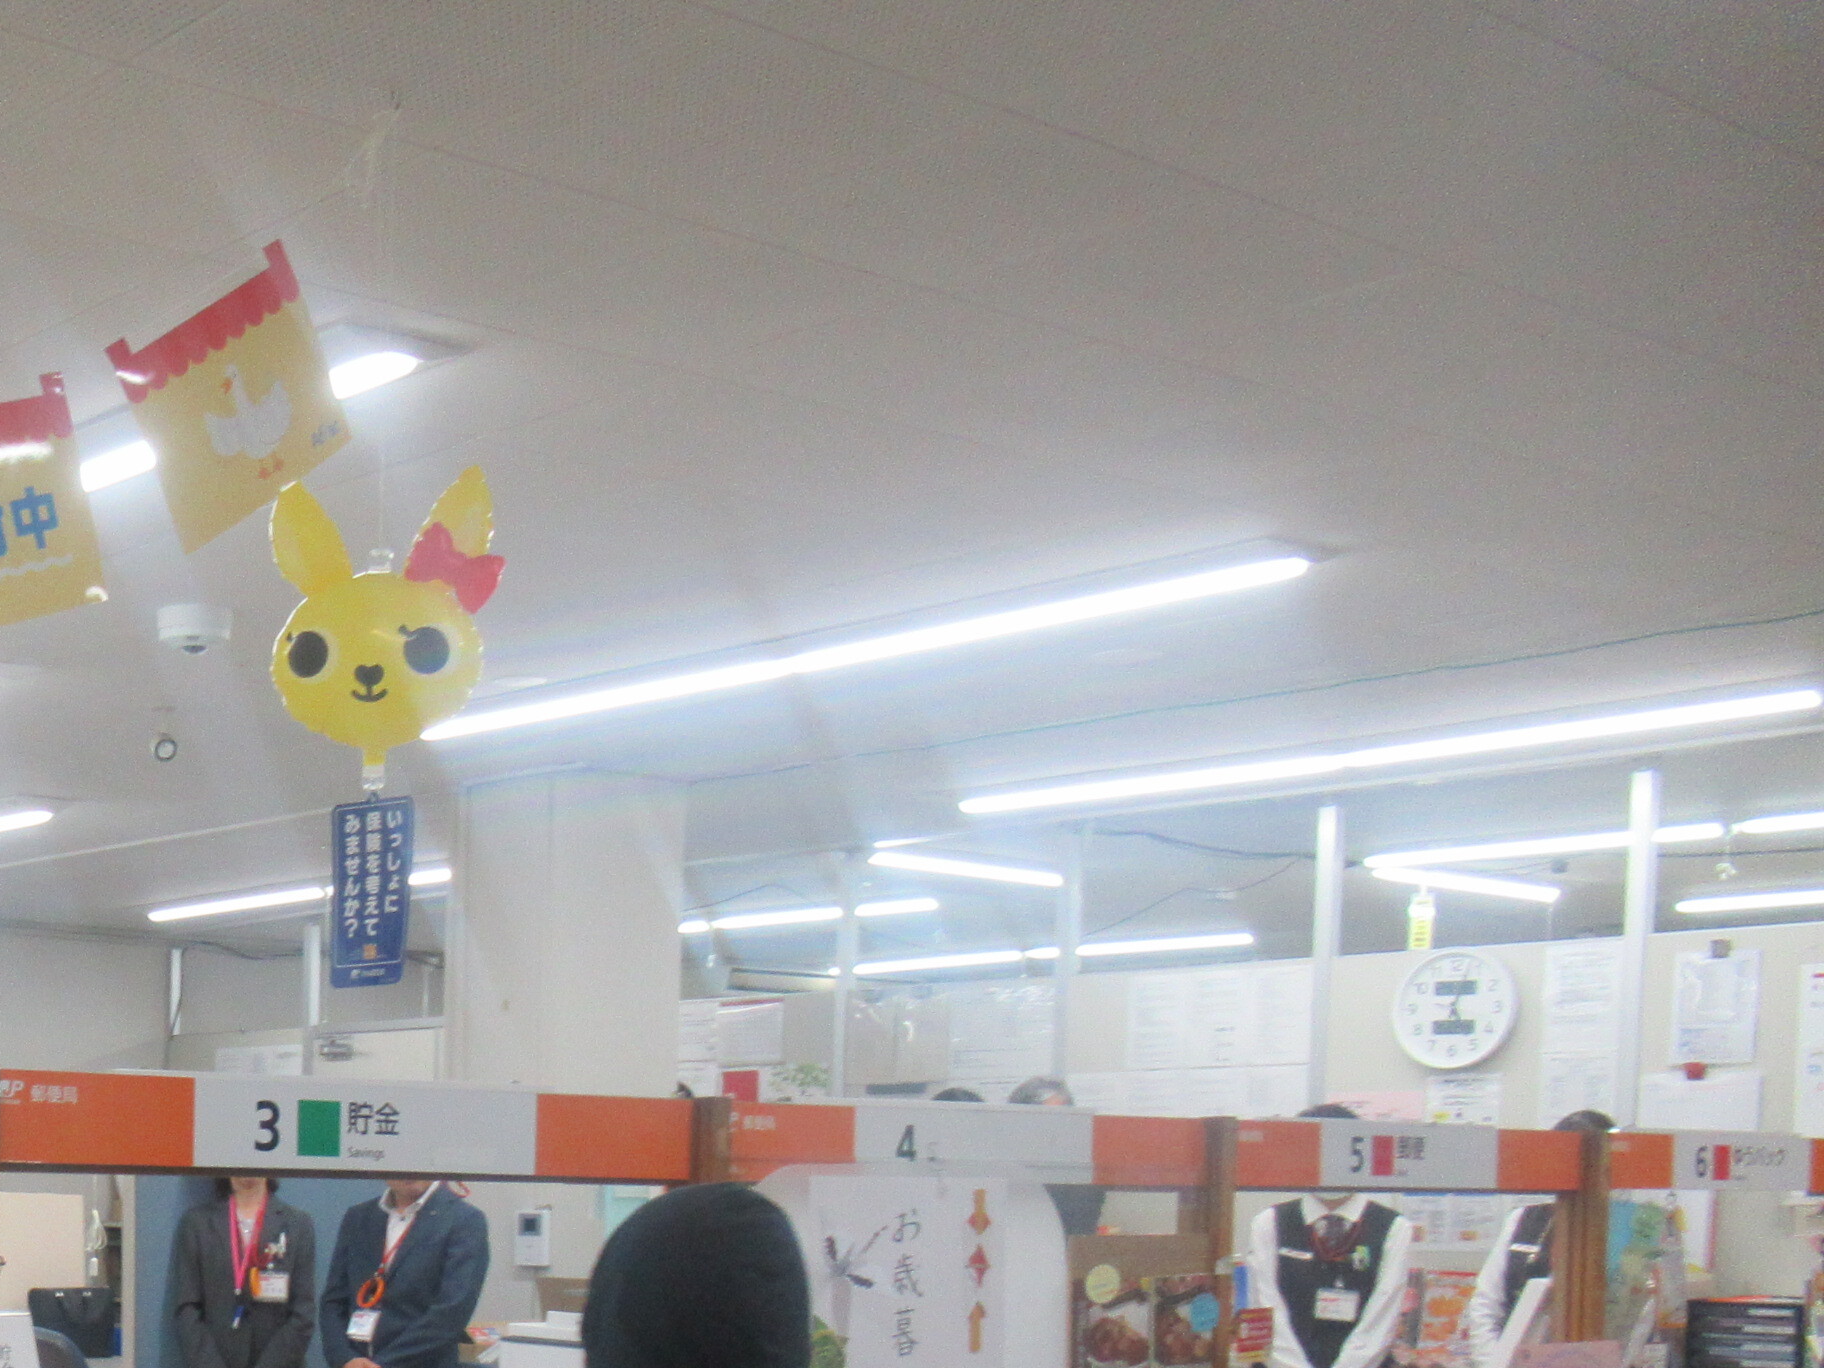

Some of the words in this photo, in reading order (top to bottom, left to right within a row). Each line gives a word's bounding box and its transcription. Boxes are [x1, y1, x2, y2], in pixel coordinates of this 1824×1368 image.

[363, 810, 382, 937] 保険を考えて
[384, 809, 403, 914] いっしょに
[253, 1099, 282, 1153] 3
[347, 1100, 401, 1139] 貯金
[347, 1146, 385, 1161] Savings
[894, 1123, 918, 1163] 4
[1350, 1135, 1365, 1174] 5
[1694, 1145, 1709, 1179] 6
[891, 1207, 925, 1358] お歳暮
